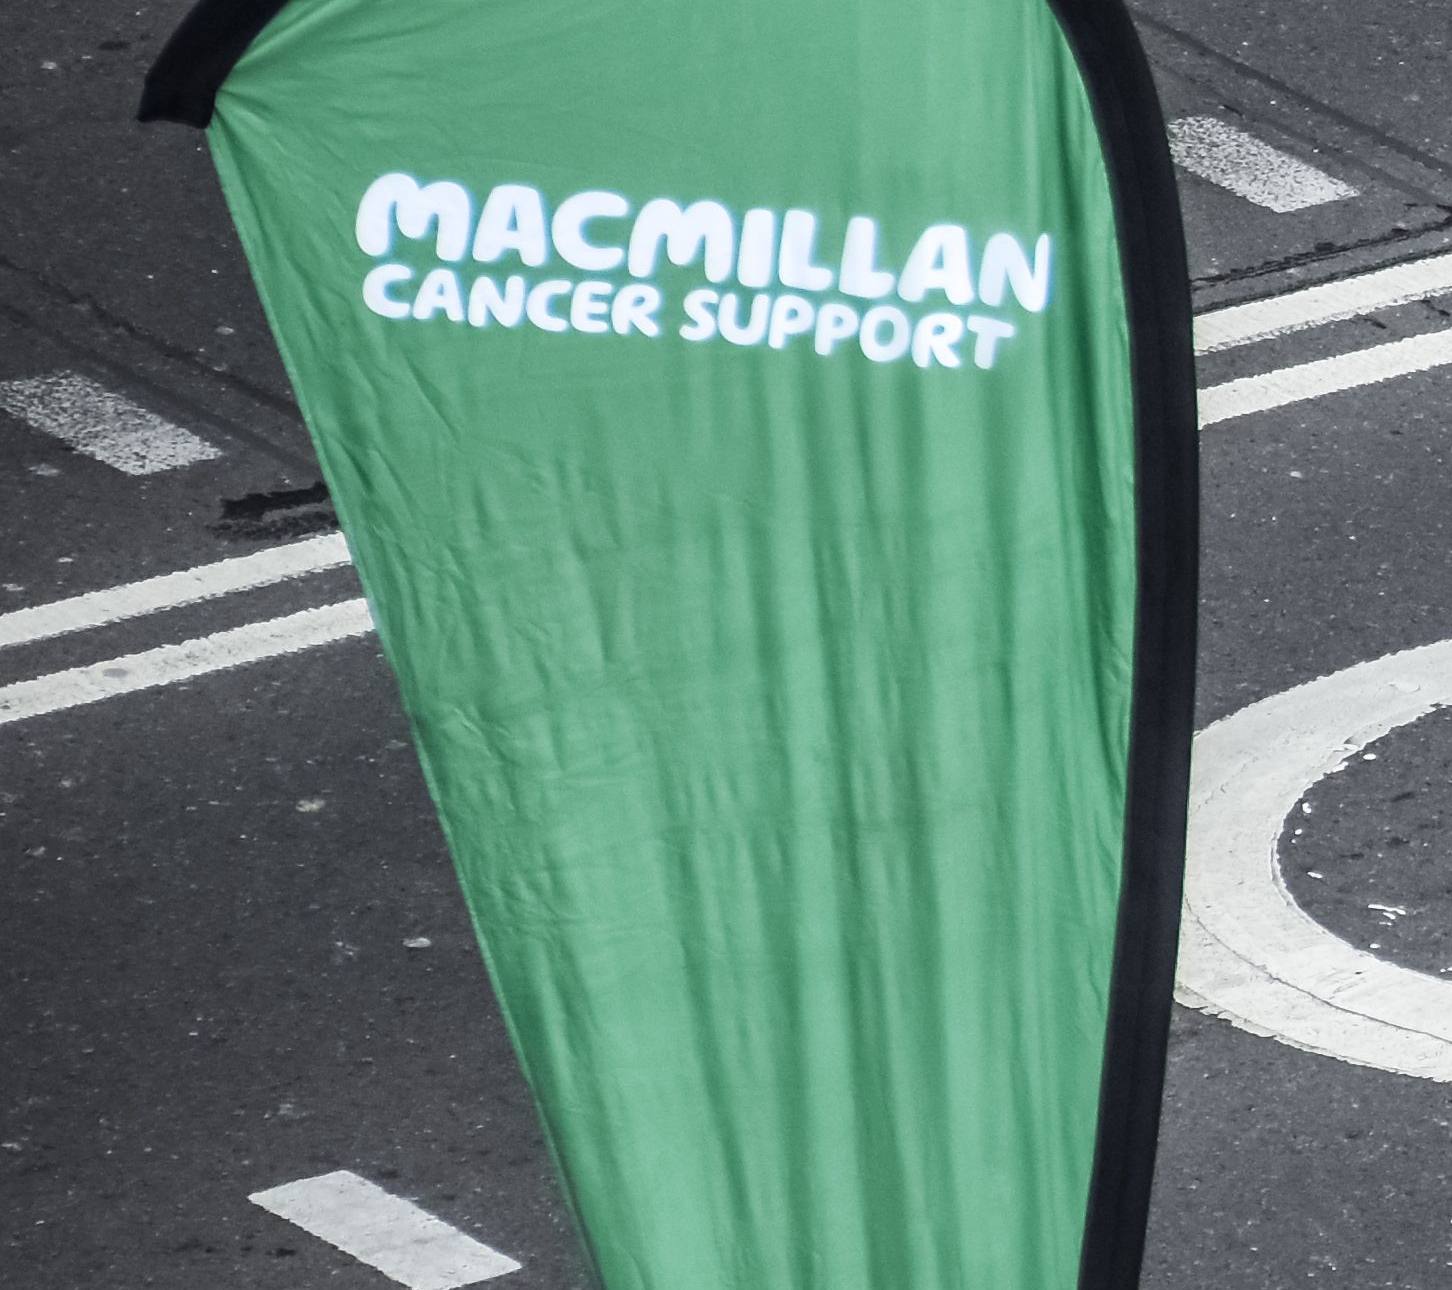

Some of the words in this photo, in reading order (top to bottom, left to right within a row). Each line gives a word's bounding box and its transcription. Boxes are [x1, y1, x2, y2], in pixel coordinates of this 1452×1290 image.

[355, 171, 1052, 313] MACMILLAN
[362, 263, 662, 338] CANCER
[678, 287, 1016, 371] SUPPORT
